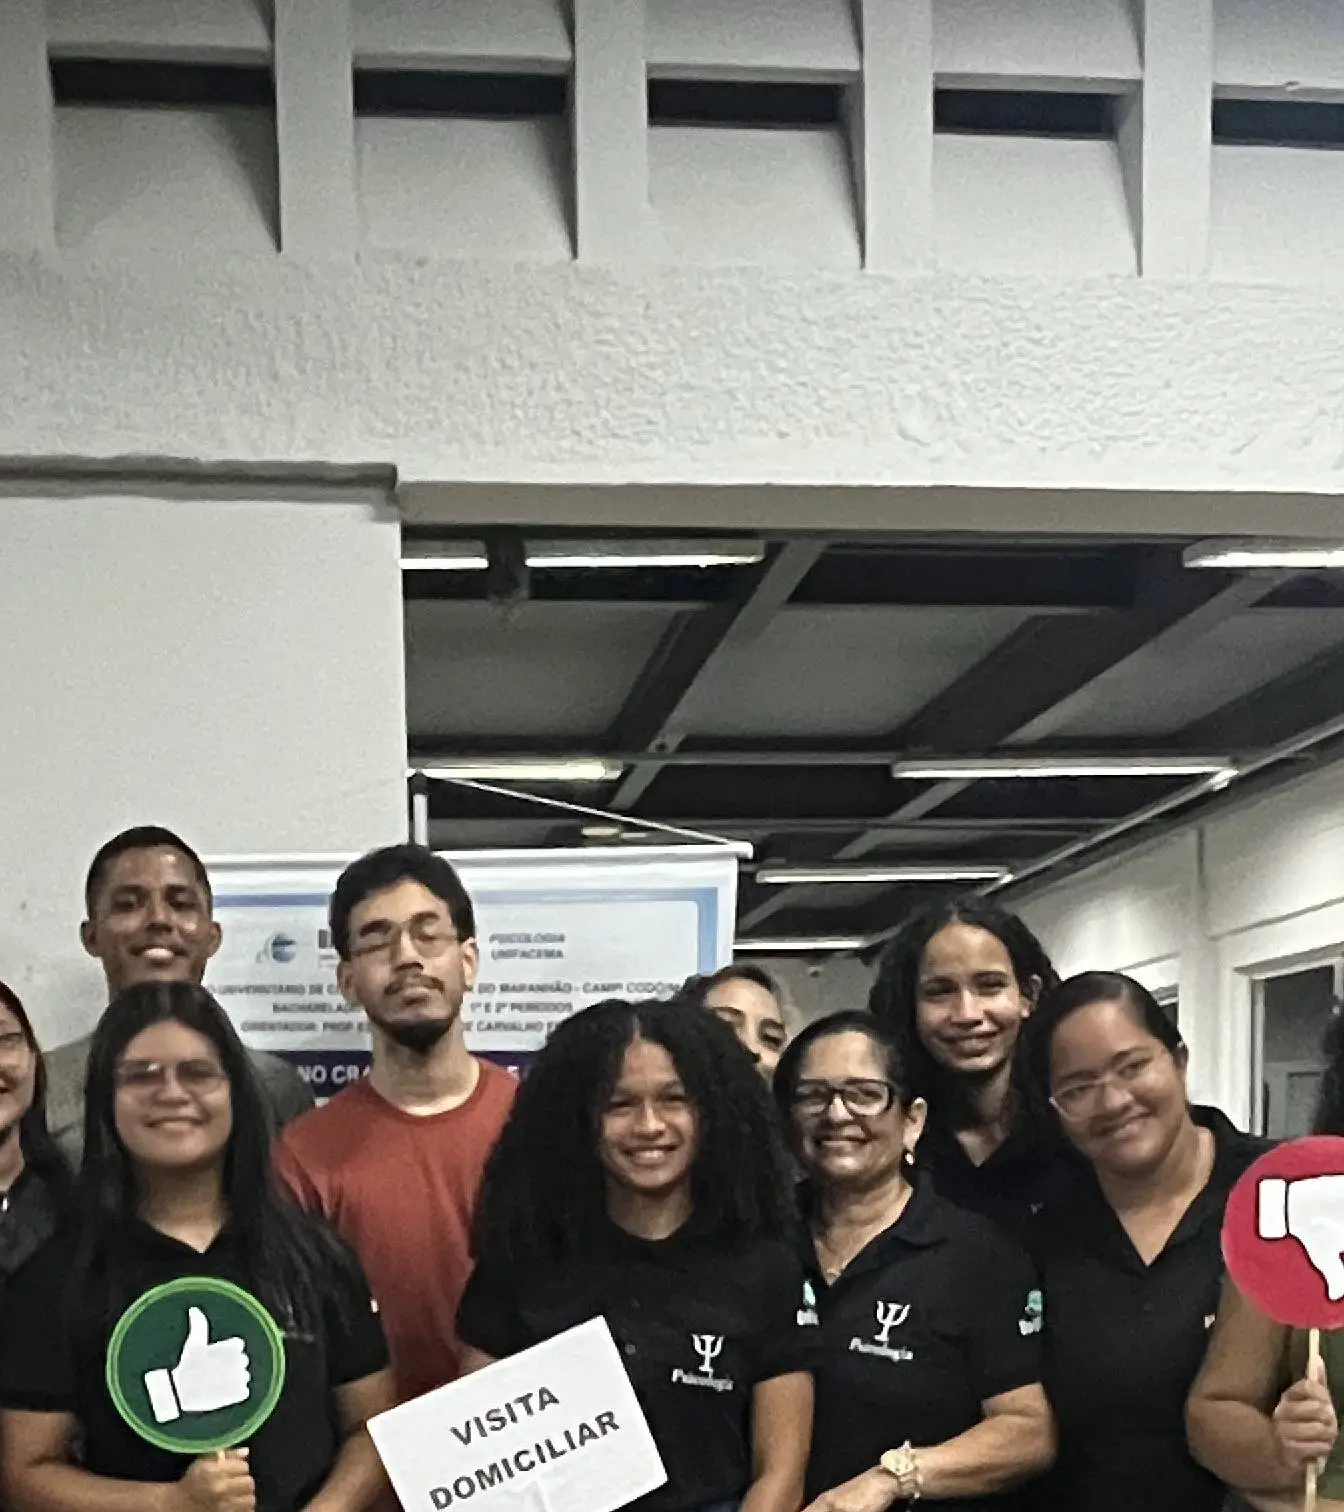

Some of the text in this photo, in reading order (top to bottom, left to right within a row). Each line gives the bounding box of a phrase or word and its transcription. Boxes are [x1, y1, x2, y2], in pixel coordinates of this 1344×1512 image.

[297, 1065, 327, 1084] NO
[450, 1386, 560, 1446] VISITA
[429, 1410, 620, 1511] DOMICILIAR
